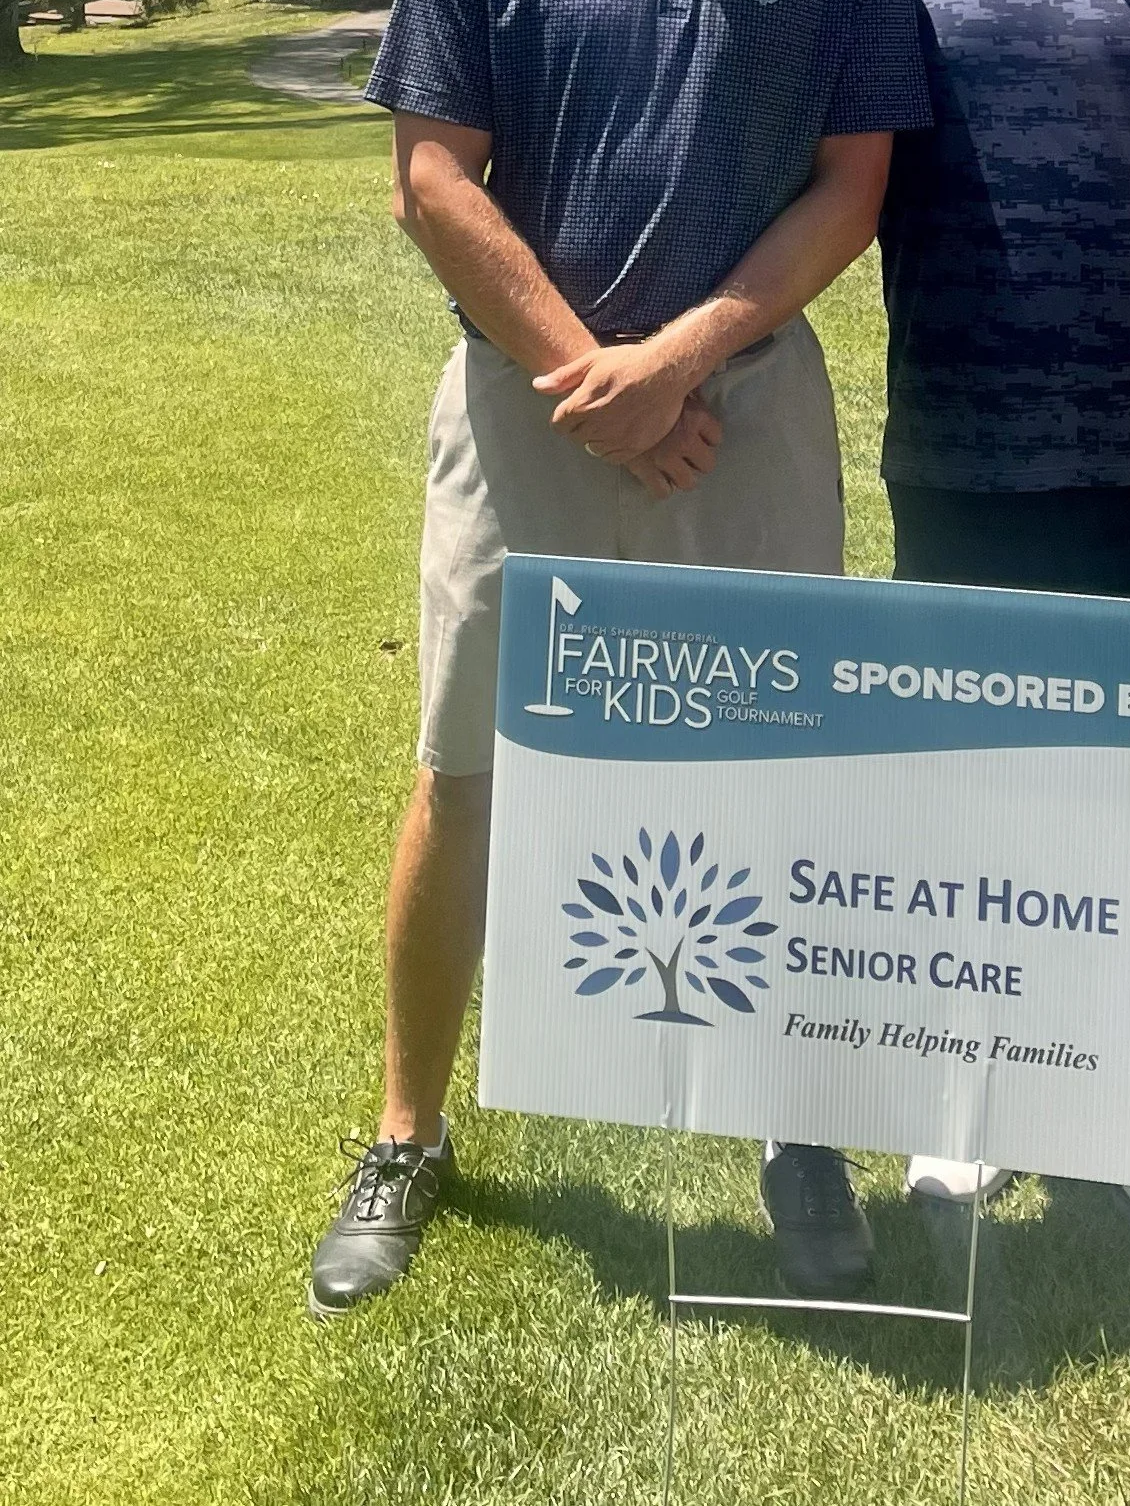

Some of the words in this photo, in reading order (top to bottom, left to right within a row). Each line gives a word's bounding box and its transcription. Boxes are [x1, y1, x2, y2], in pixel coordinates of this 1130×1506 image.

[581, 624, 607, 636] RICH
[611, 626, 658, 640] SHAPIRO
[662, 631, 718, 644] MEMORIAL
[557, 633, 800, 692] FAIRWAYS
[832, 659, 1106, 714] SPONSORED
[565, 677, 602, 696] FOR
[604, 680, 713, 729] KIDS
[716, 689, 758, 706] GOLF
[716, 705, 824, 728] TOURNAMENT
[789, 858, 895, 912] SAFE
[907, 879, 965, 919] AT
[978, 876, 1120, 936] HOME
[786, 936, 917, 985] SENIOR
[929, 951, 1023, 997] CARE
[783, 1012, 871, 1050] Family
[877, 1022, 982, 1064] Helping
[988, 1035, 1100, 1072] Families
